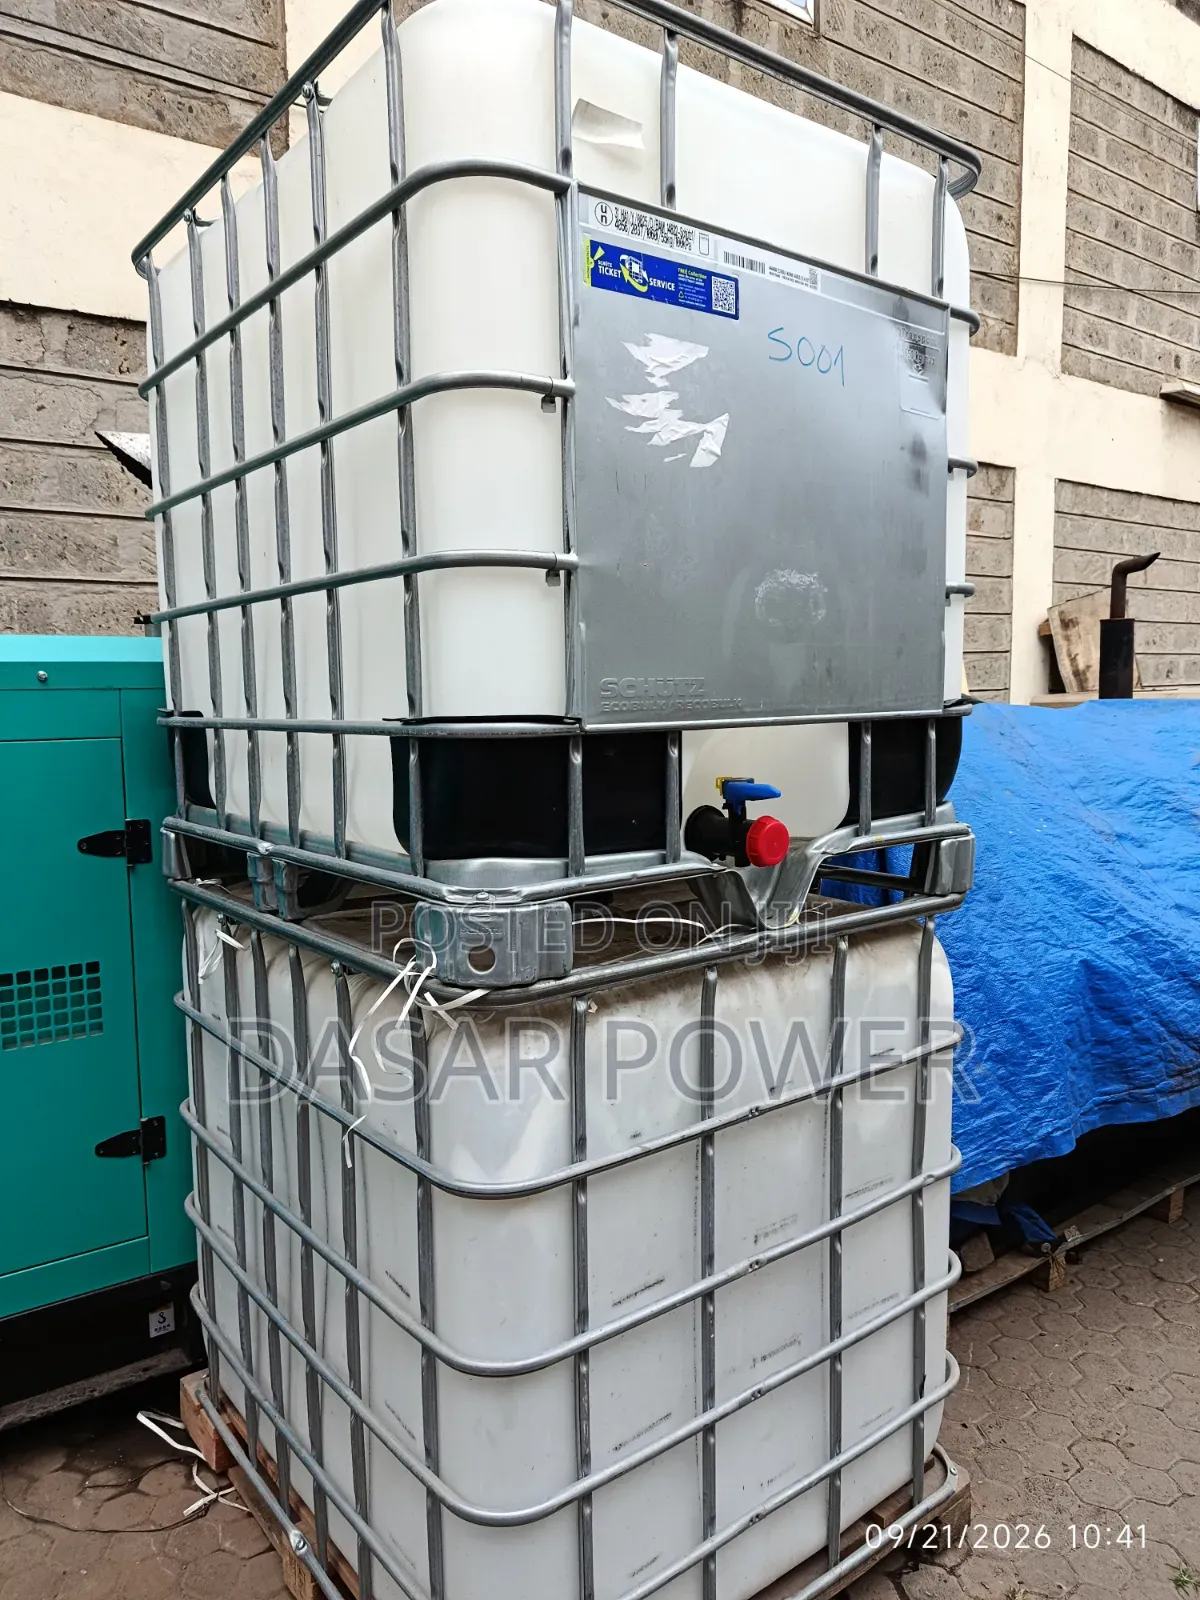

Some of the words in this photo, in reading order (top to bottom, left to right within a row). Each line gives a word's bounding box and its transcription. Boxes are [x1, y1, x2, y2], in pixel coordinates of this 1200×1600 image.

[598, 266, 622, 279] TICKET
[649, 276, 676, 292] SERVICE
[600, 676, 705, 699] SCHÜTZ
